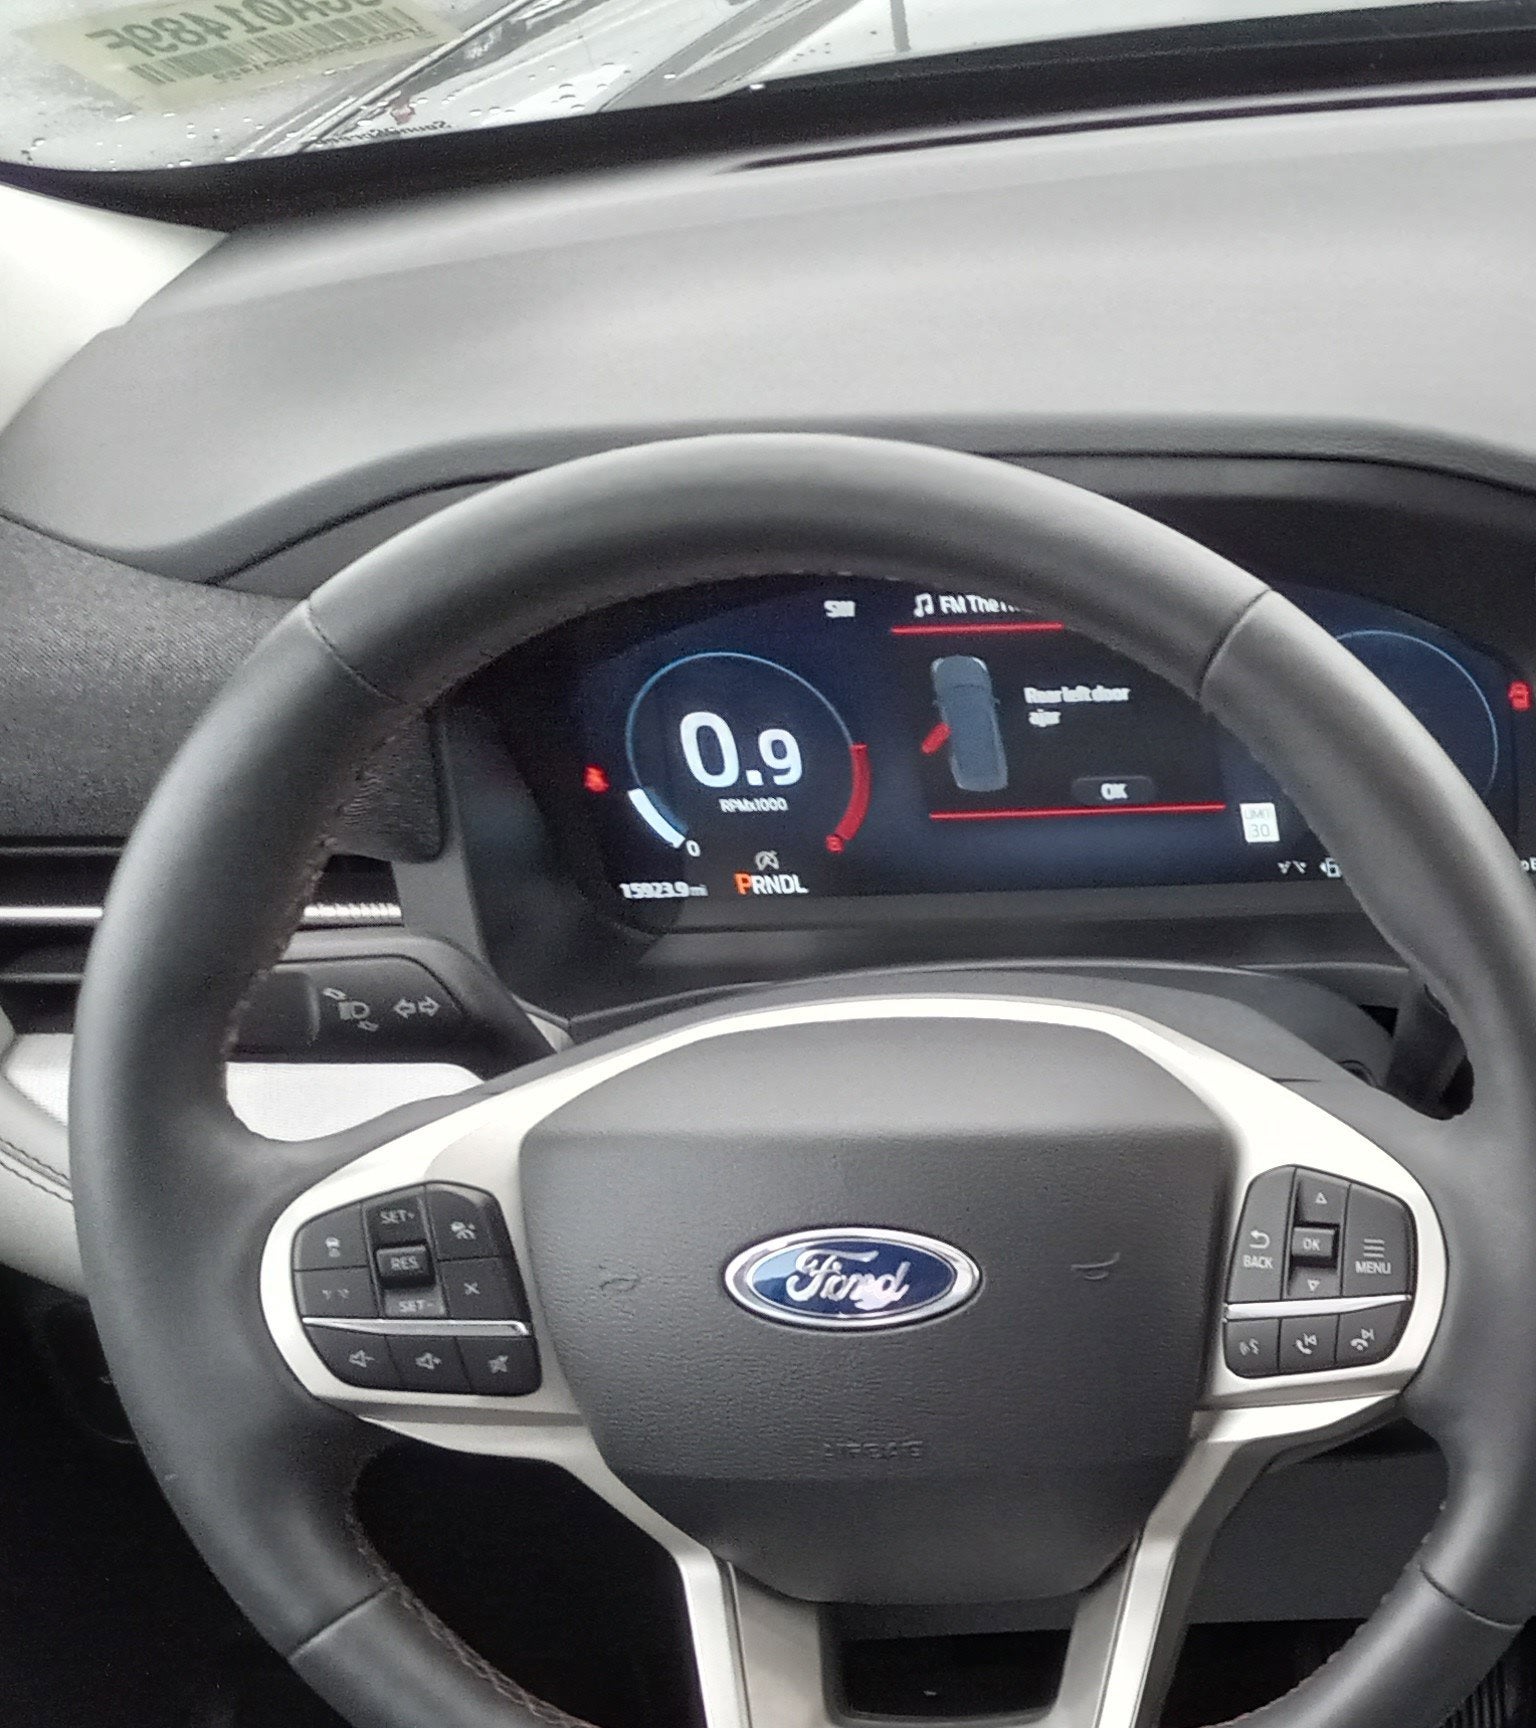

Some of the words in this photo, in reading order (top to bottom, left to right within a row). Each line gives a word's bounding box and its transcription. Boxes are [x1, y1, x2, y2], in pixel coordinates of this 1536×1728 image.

[680, 711, 802, 787] 0.9
[686, 839, 701, 857] 0
[1302, 1238, 1320, 1251] OK
[390, 1256, 419, 1270] RES
[1243, 1256, 1274, 1269] BACK
[1355, 1260, 1392, 1274] MENU
[785, 1249, 911, 1309] Ford
